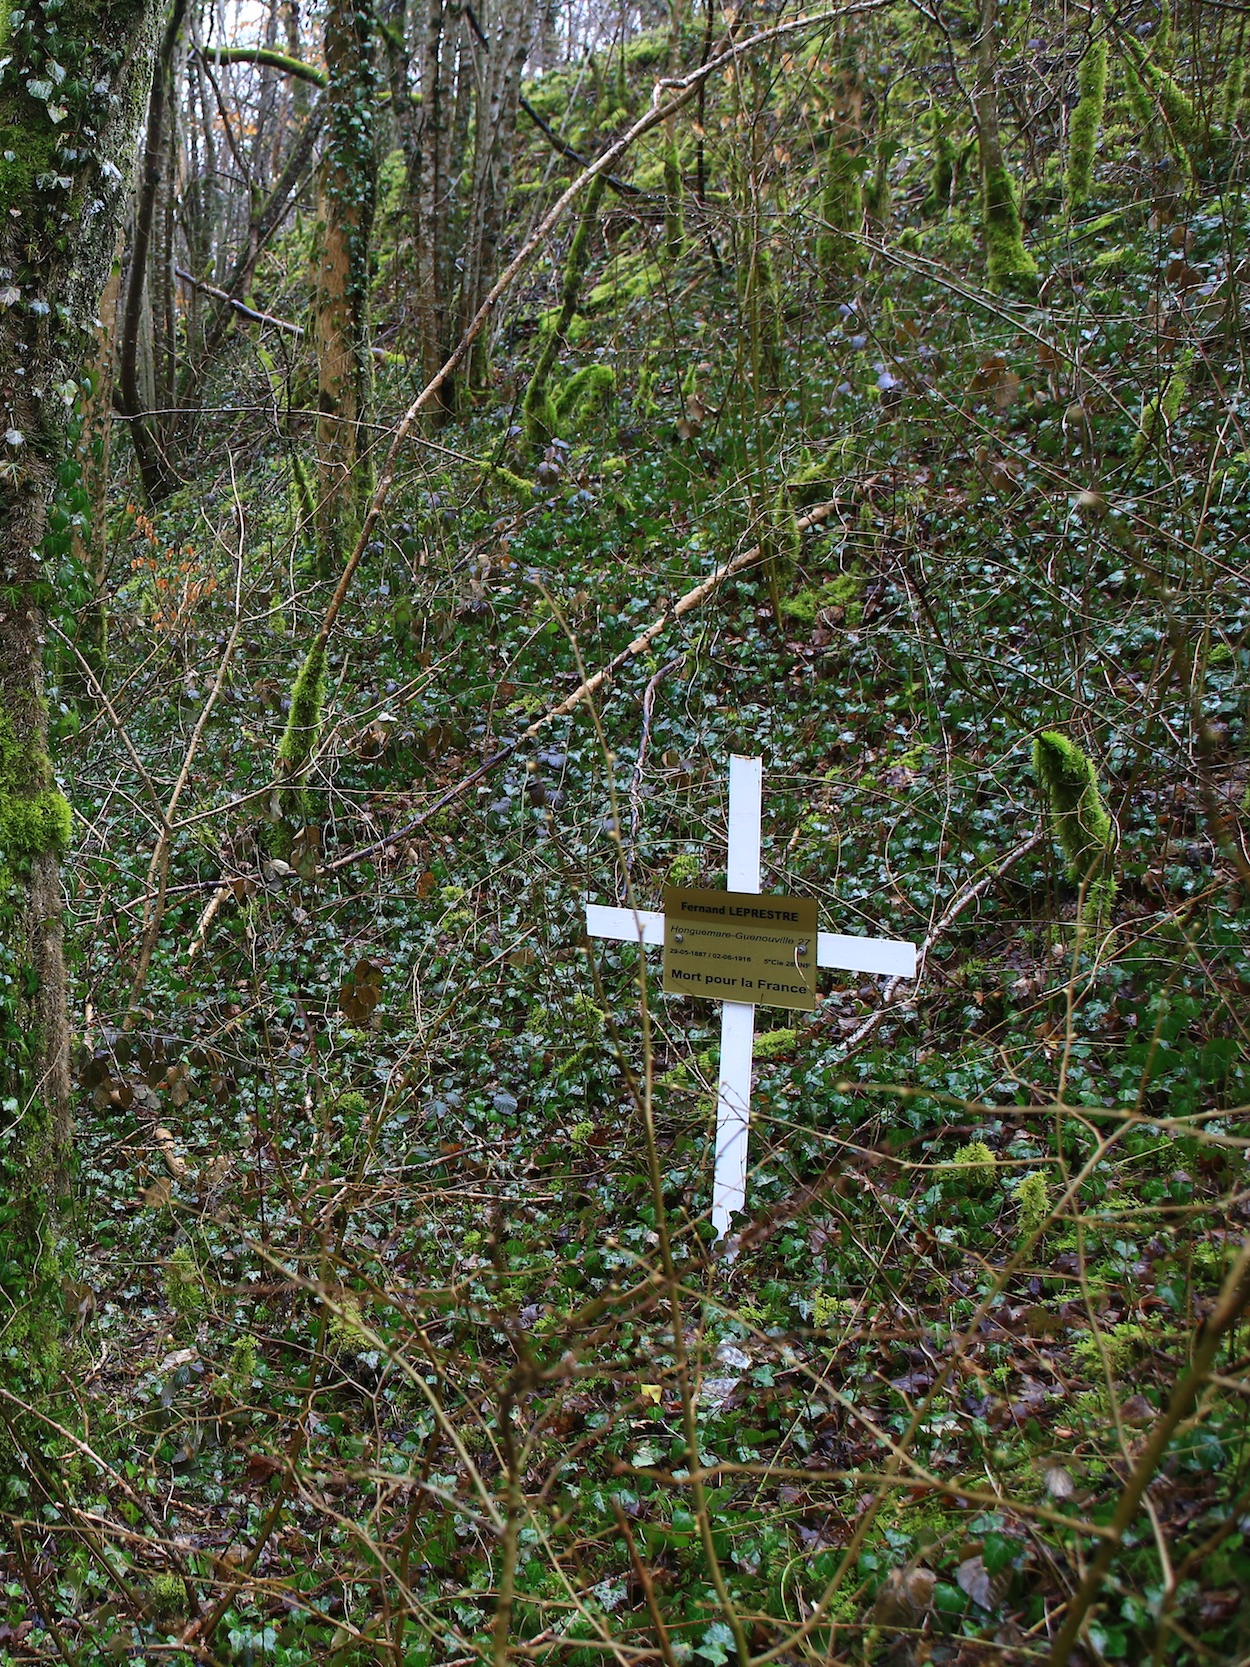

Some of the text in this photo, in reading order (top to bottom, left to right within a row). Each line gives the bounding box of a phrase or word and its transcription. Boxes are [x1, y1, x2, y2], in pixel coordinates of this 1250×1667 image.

[681, 902, 799, 922] Fernand LEPRESTRE
[670, 925, 811, 947] Honguemare-Guenouville 27
[671, 969, 807, 994] Mort pour la France
